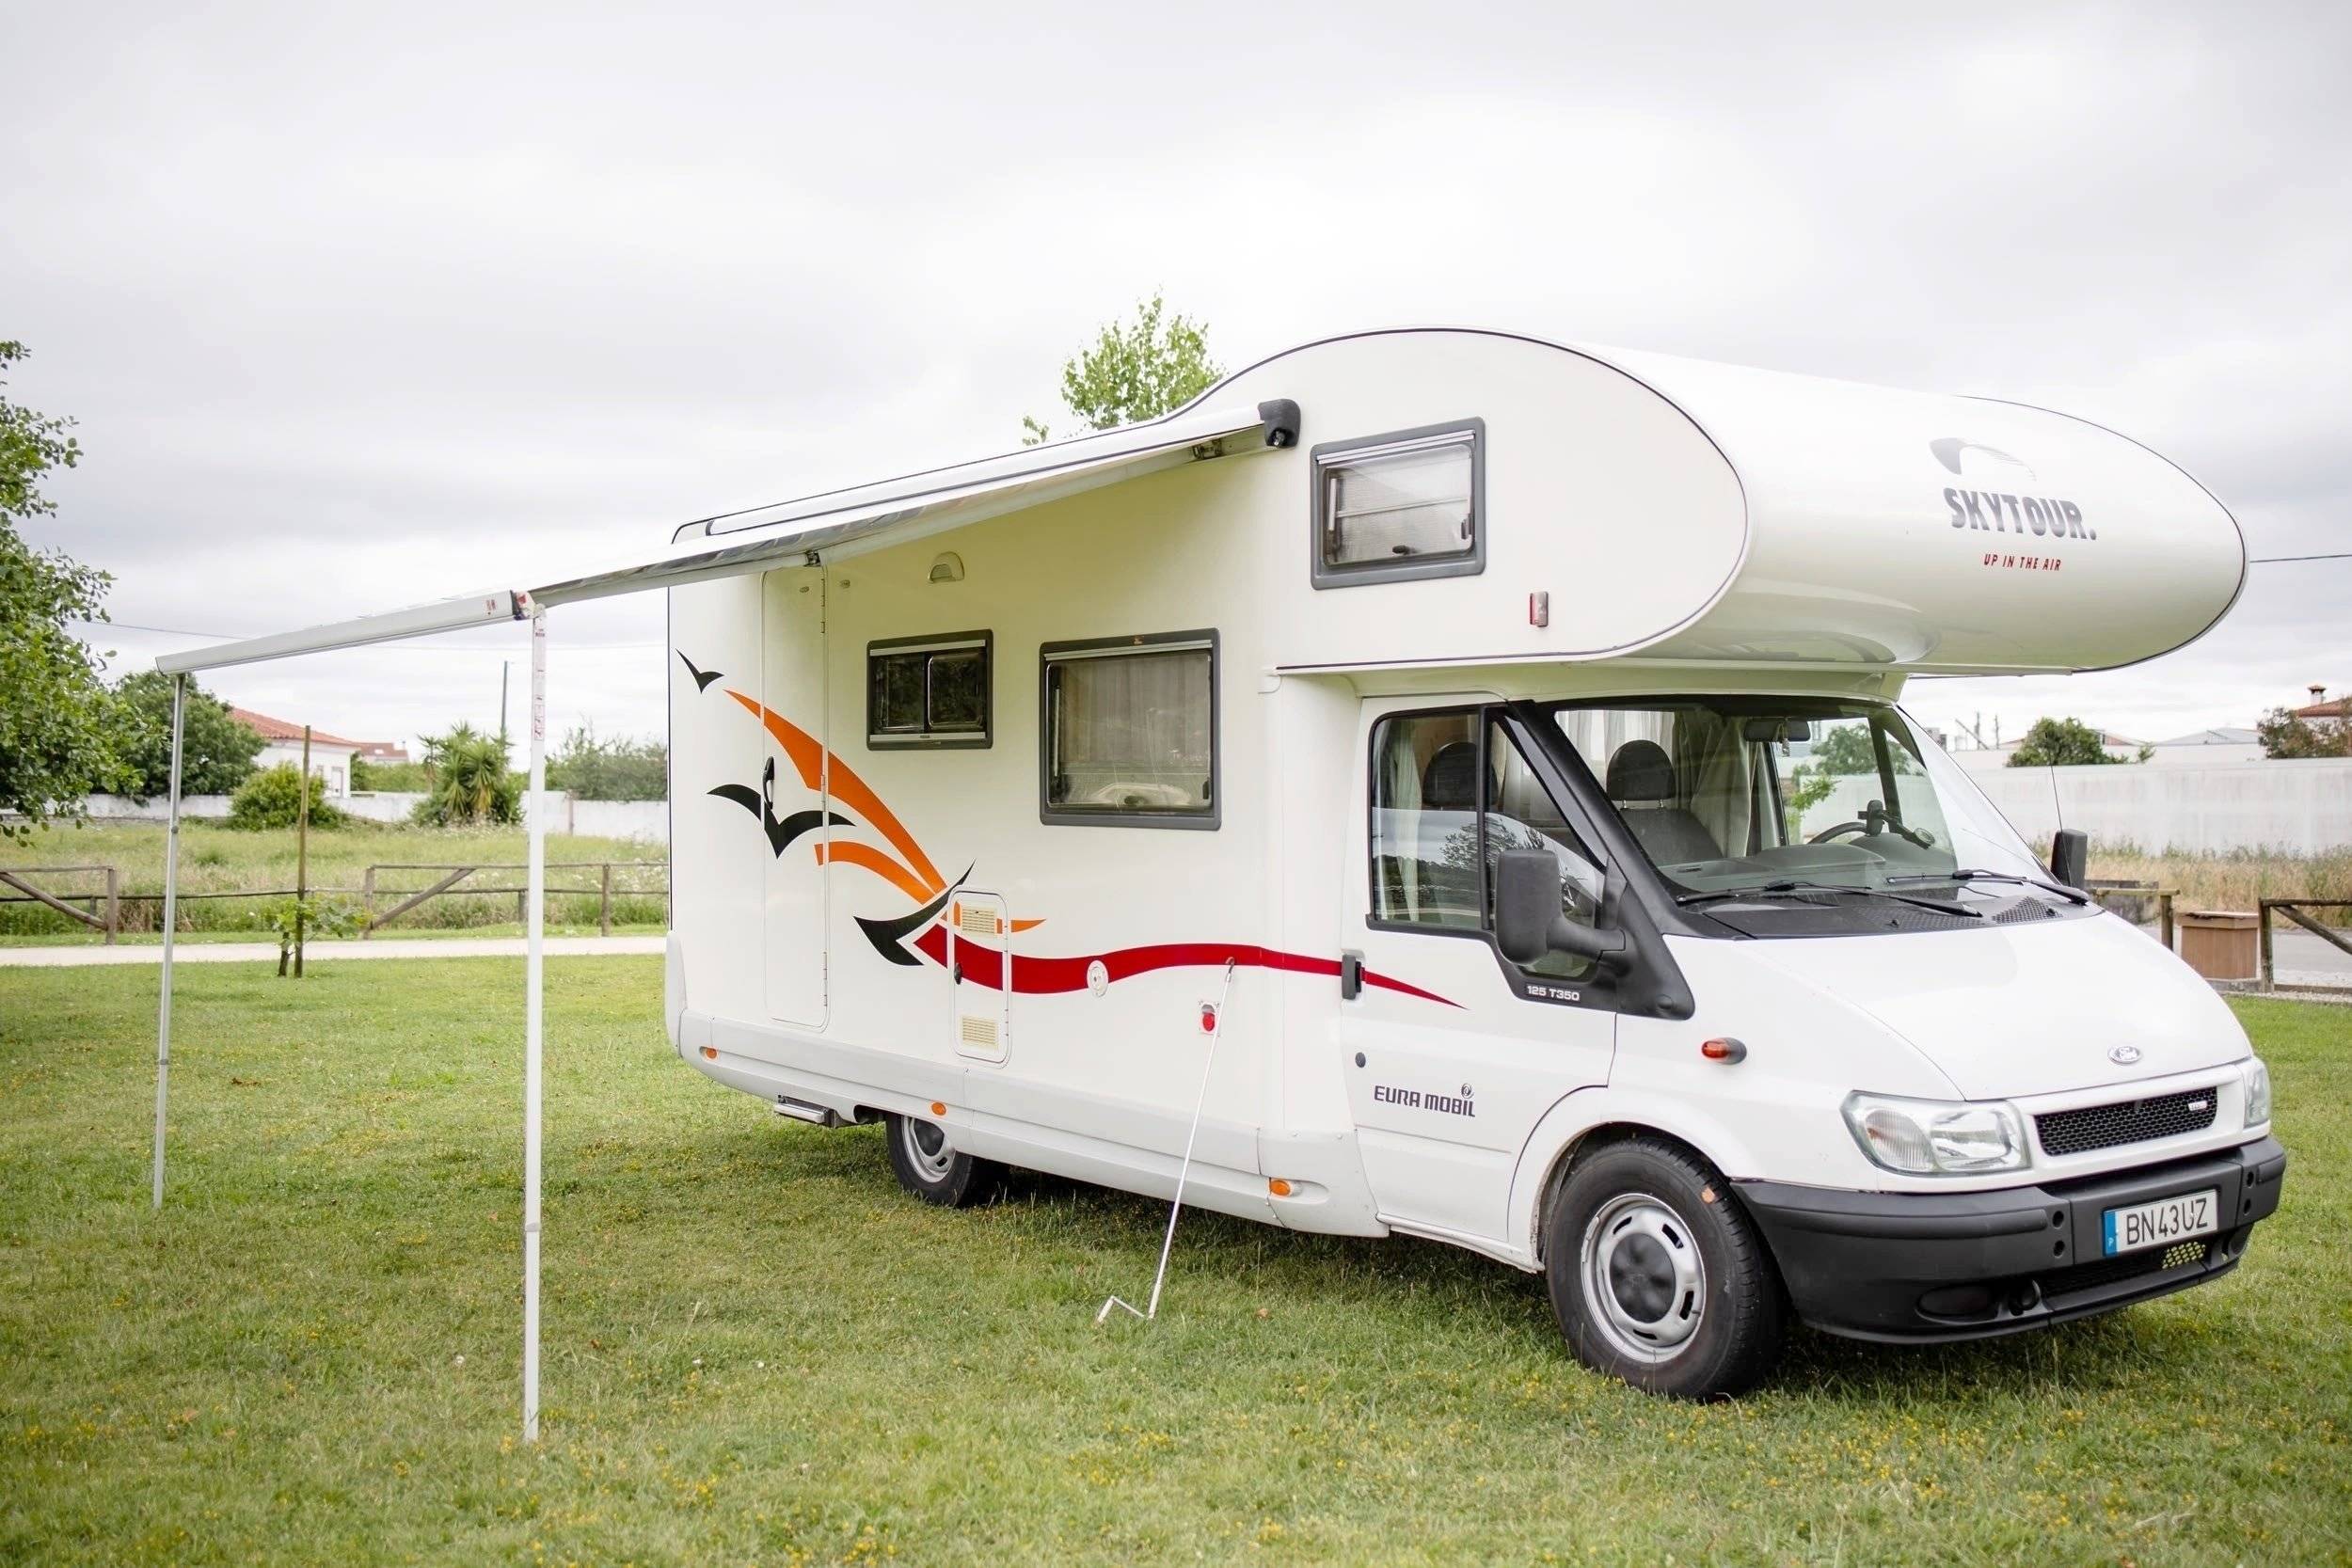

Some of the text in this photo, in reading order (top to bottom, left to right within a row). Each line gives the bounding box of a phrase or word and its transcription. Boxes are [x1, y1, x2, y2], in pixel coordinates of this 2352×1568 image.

[1983, 553, 2062, 571] UP IN THE AIR
[1527, 985, 1581, 1002] 125 T350
[1374, 1085, 1475, 1118] EURA MOBIL
[2125, 1197, 2208, 1245] BN43UZ
